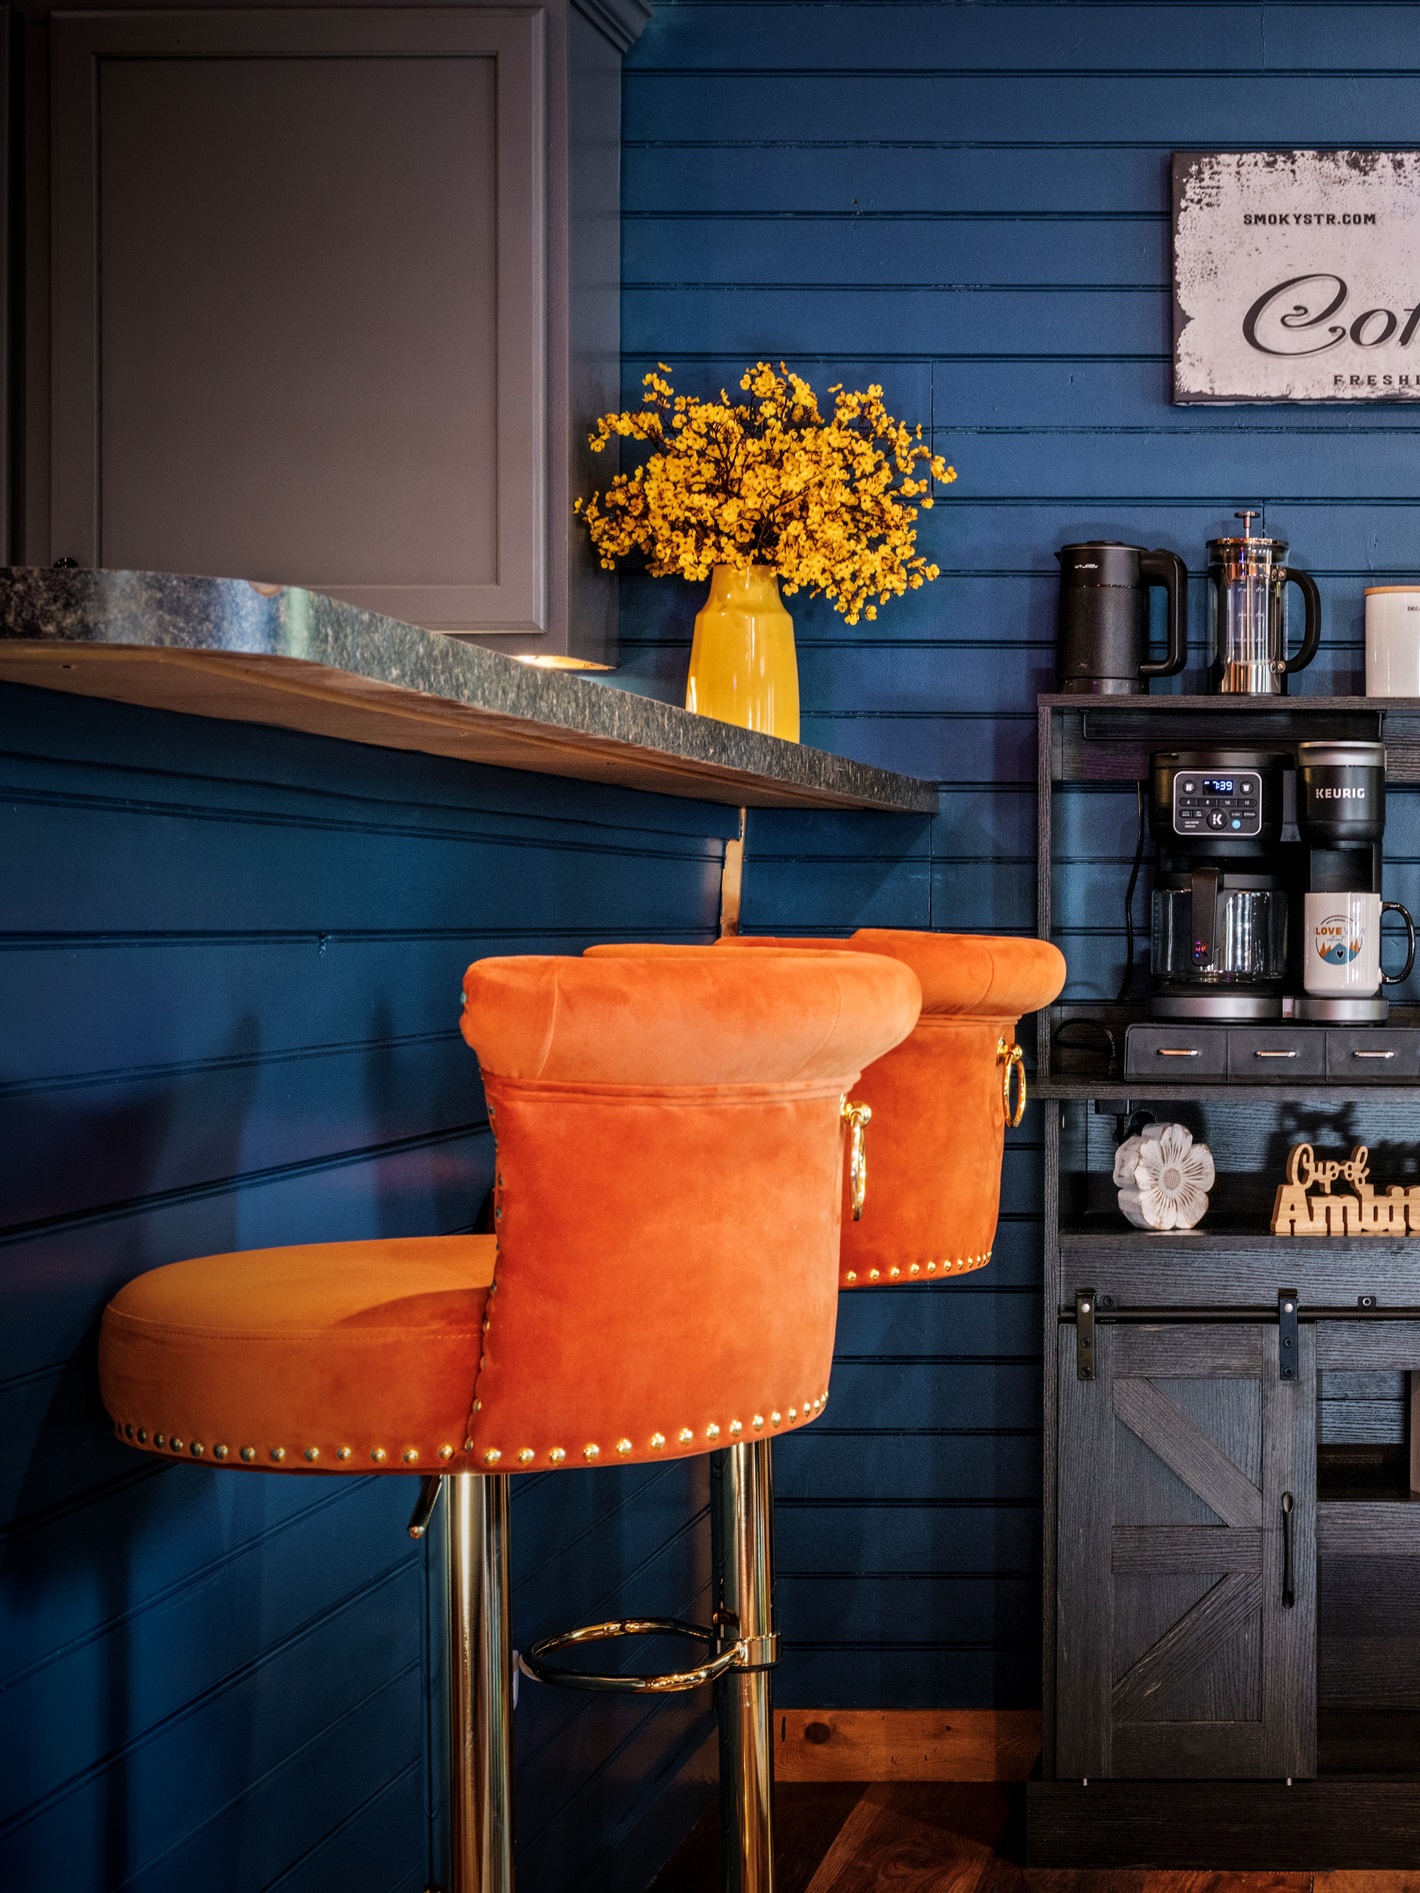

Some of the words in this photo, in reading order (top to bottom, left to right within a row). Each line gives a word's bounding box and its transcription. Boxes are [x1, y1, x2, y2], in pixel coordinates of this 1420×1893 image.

[1243, 213, 1377, 225] SMOKYSTR.COM
[1212, 780, 1233, 791] 7:39
[1315, 787, 1366, 799] KEURIG
[1315, 926, 1343, 936] LOVE
[1287, 1143, 1340, 1195] Cup
